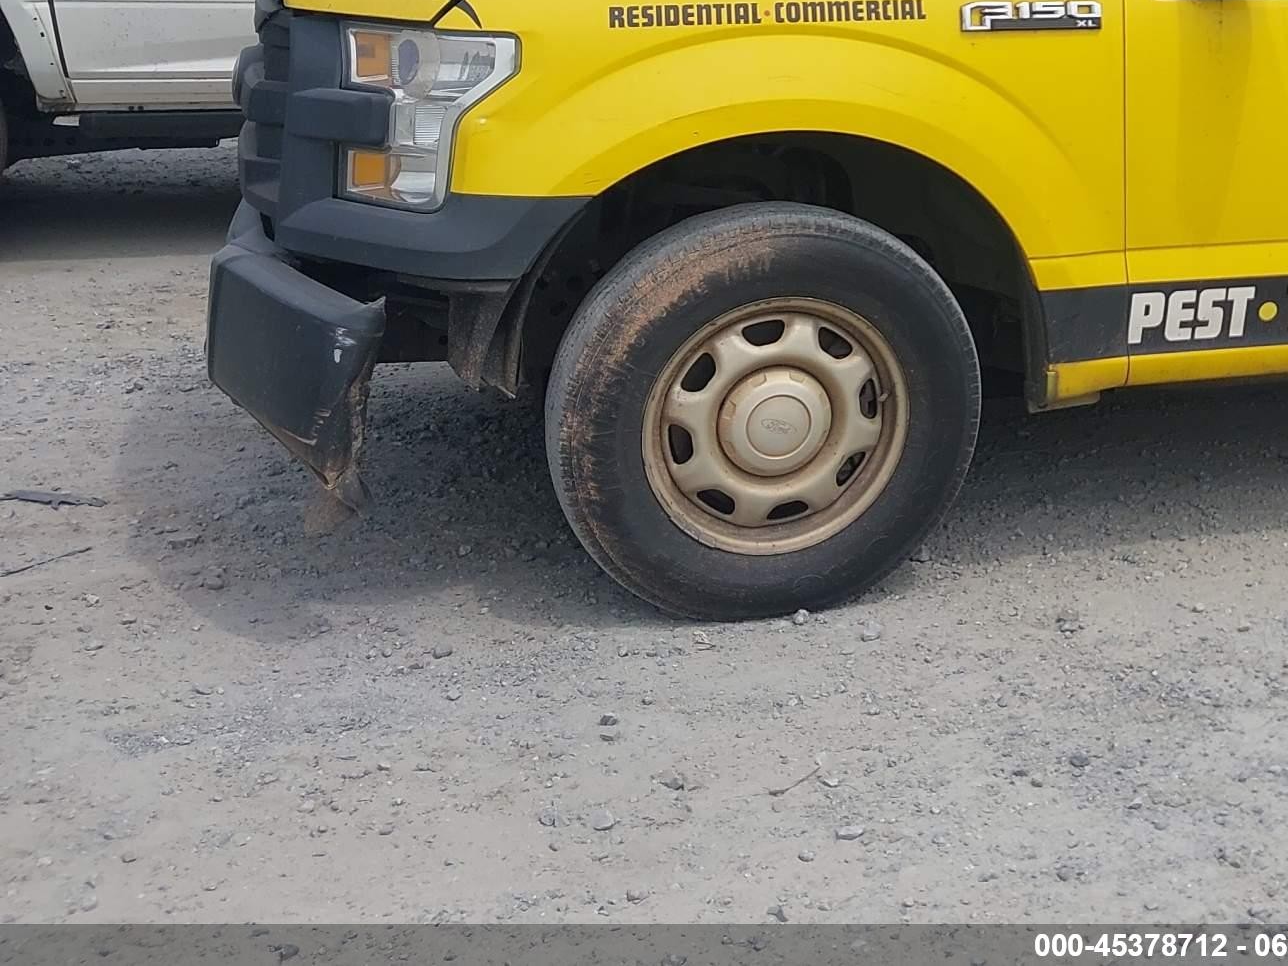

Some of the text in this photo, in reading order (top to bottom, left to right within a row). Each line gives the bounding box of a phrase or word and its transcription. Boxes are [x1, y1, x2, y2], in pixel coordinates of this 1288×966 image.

[608, 0, 927, 28] RESIDENTIAL COMMERCIAL
[1075, 19, 1097, 27] XL
[1128, 286, 1256, 344] PEST
